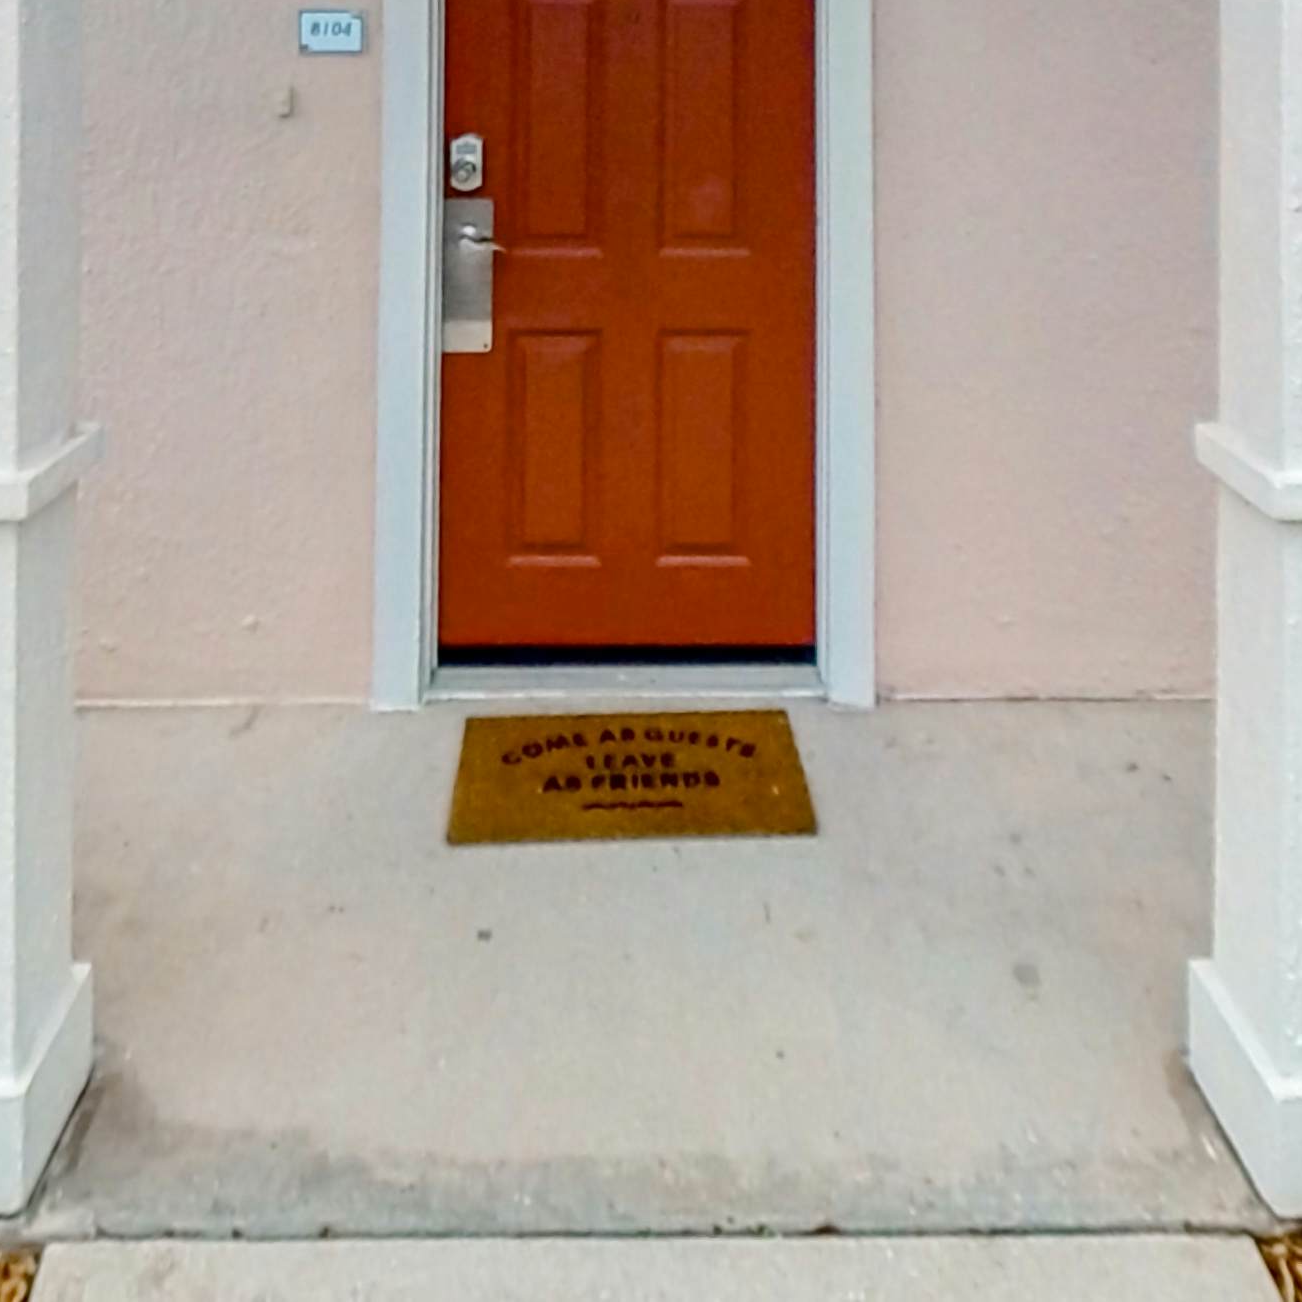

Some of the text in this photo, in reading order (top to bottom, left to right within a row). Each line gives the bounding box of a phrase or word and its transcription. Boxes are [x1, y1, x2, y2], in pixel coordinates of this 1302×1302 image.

[310, 21, 353, 37] 8104
[501, 732, 588, 765] COME
[585, 751, 675, 770] LEAVE
[590, 769, 721, 791] FRIENDS
